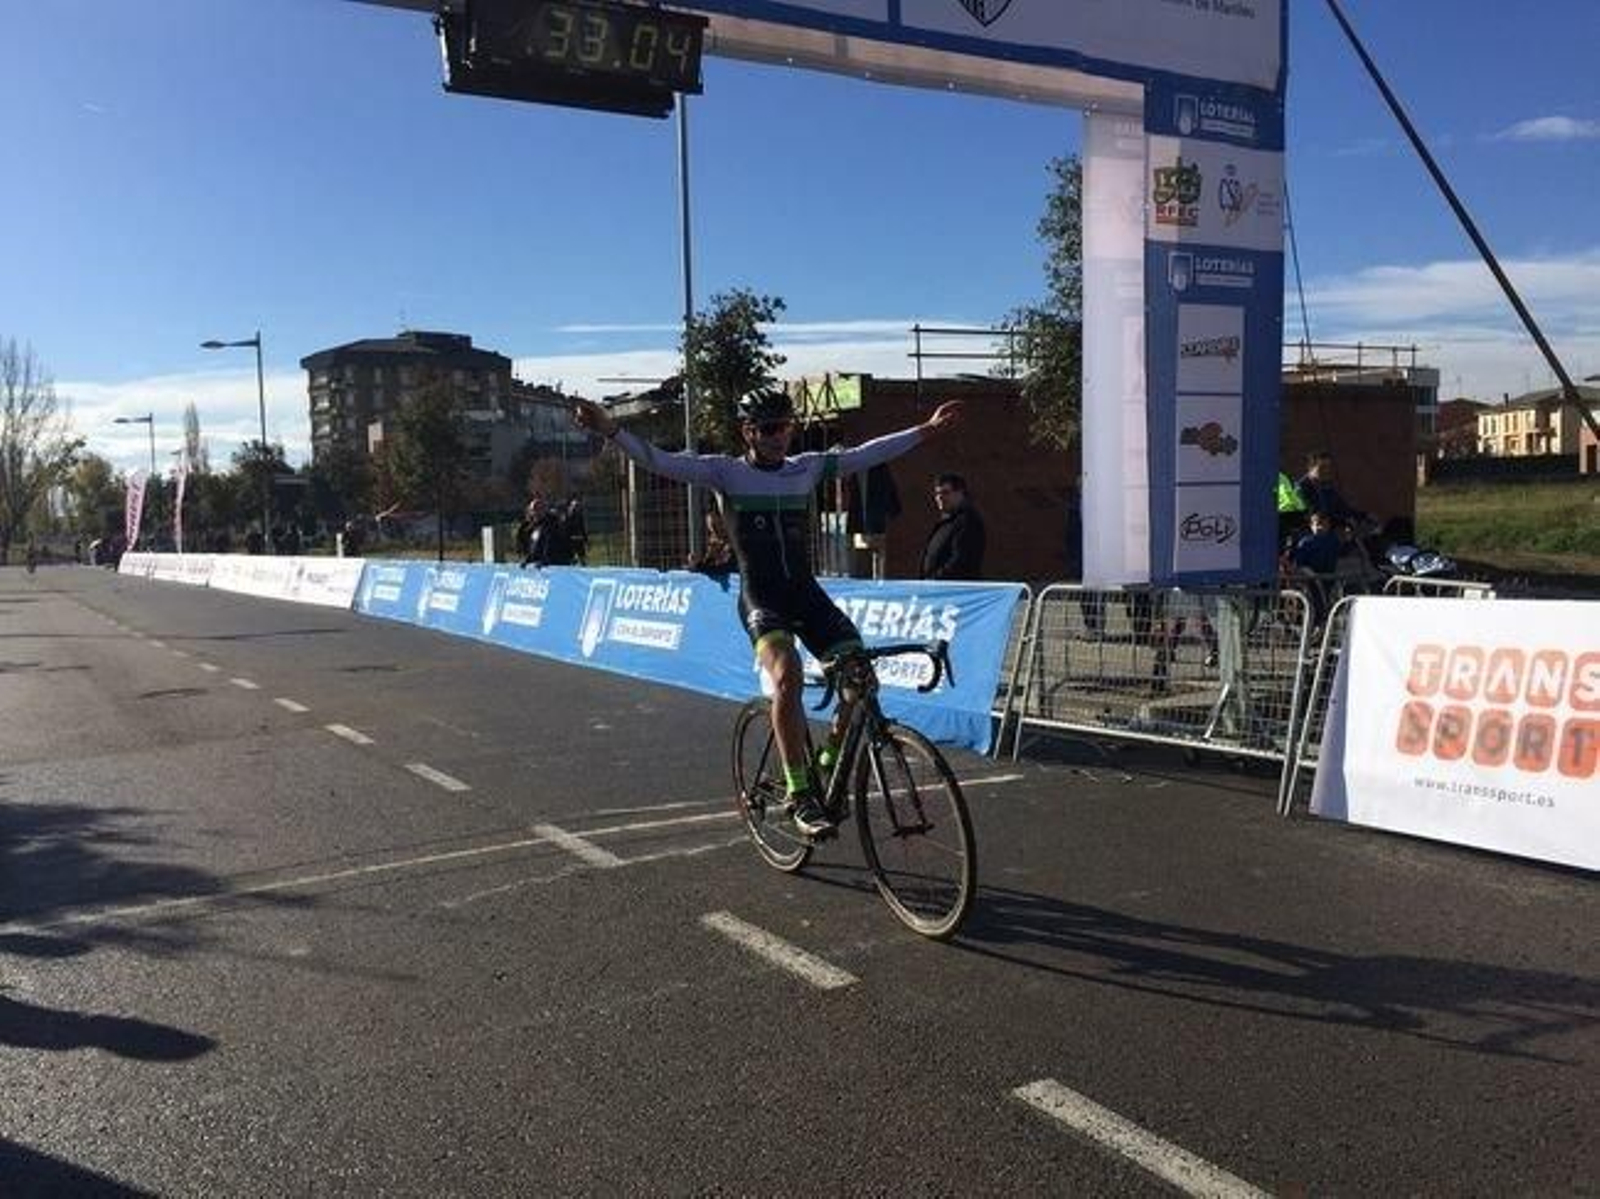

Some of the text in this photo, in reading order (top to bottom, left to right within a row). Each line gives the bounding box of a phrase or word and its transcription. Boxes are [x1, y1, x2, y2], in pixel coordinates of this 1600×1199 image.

[614, 580, 692, 615] LOTERÍAS
[832, 596, 960, 641] TERÍAS
[1412, 650, 1600, 706] TRANS
[1402, 704, 1598, 772] SPORT
[1413, 778, 1556, 807] www.transsport.es
